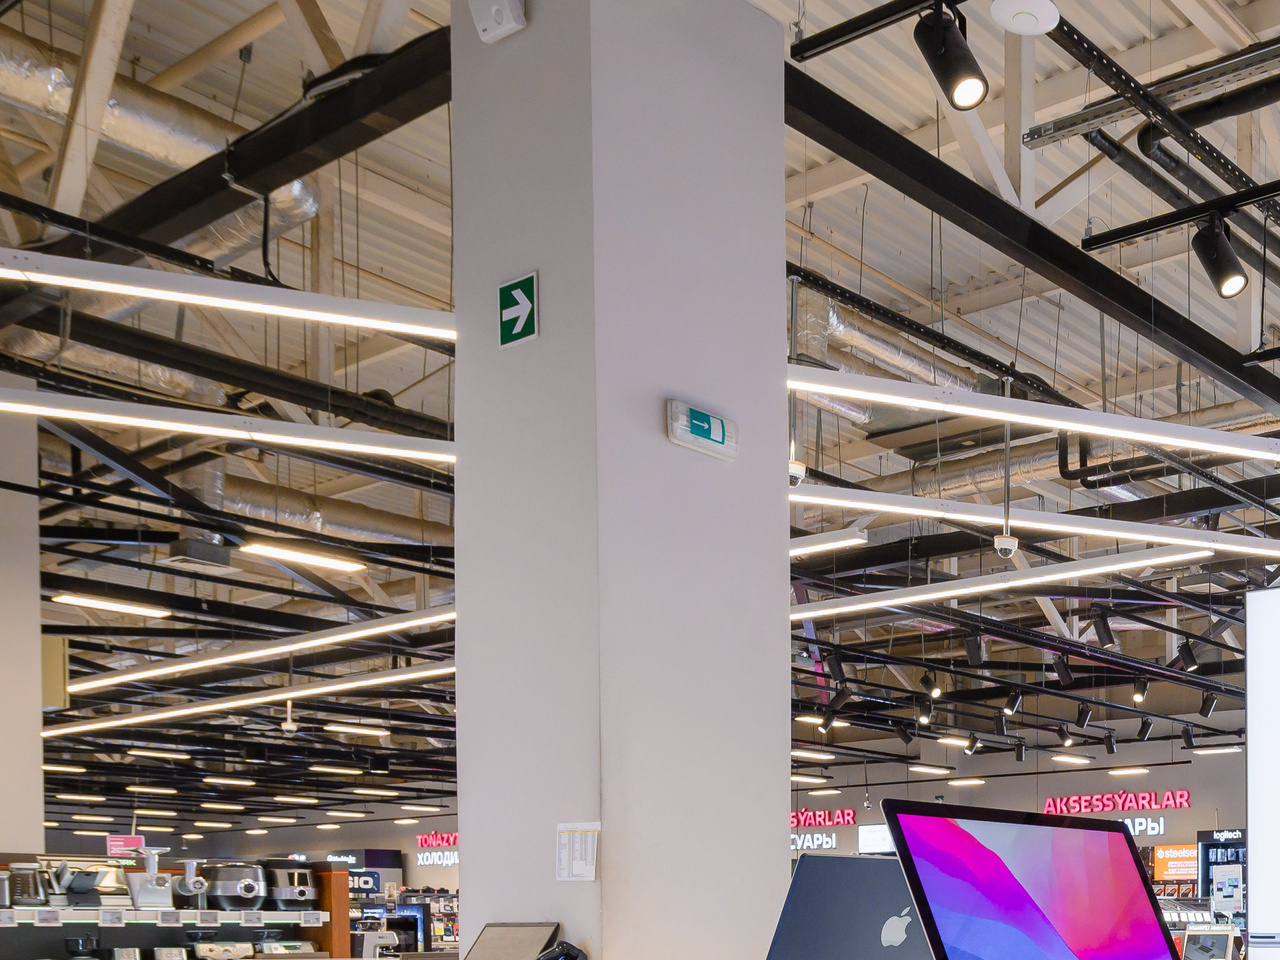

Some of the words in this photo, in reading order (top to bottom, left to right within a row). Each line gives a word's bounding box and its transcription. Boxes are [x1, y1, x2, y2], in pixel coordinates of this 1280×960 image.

[1043, 789, 1191, 815] AKSESSÝARLAR
[1118, 816, 1165, 835] АРЫ
[1213, 830, 1242, 842] logitech
[417, 851, 459, 866] ХОЛОДИ
